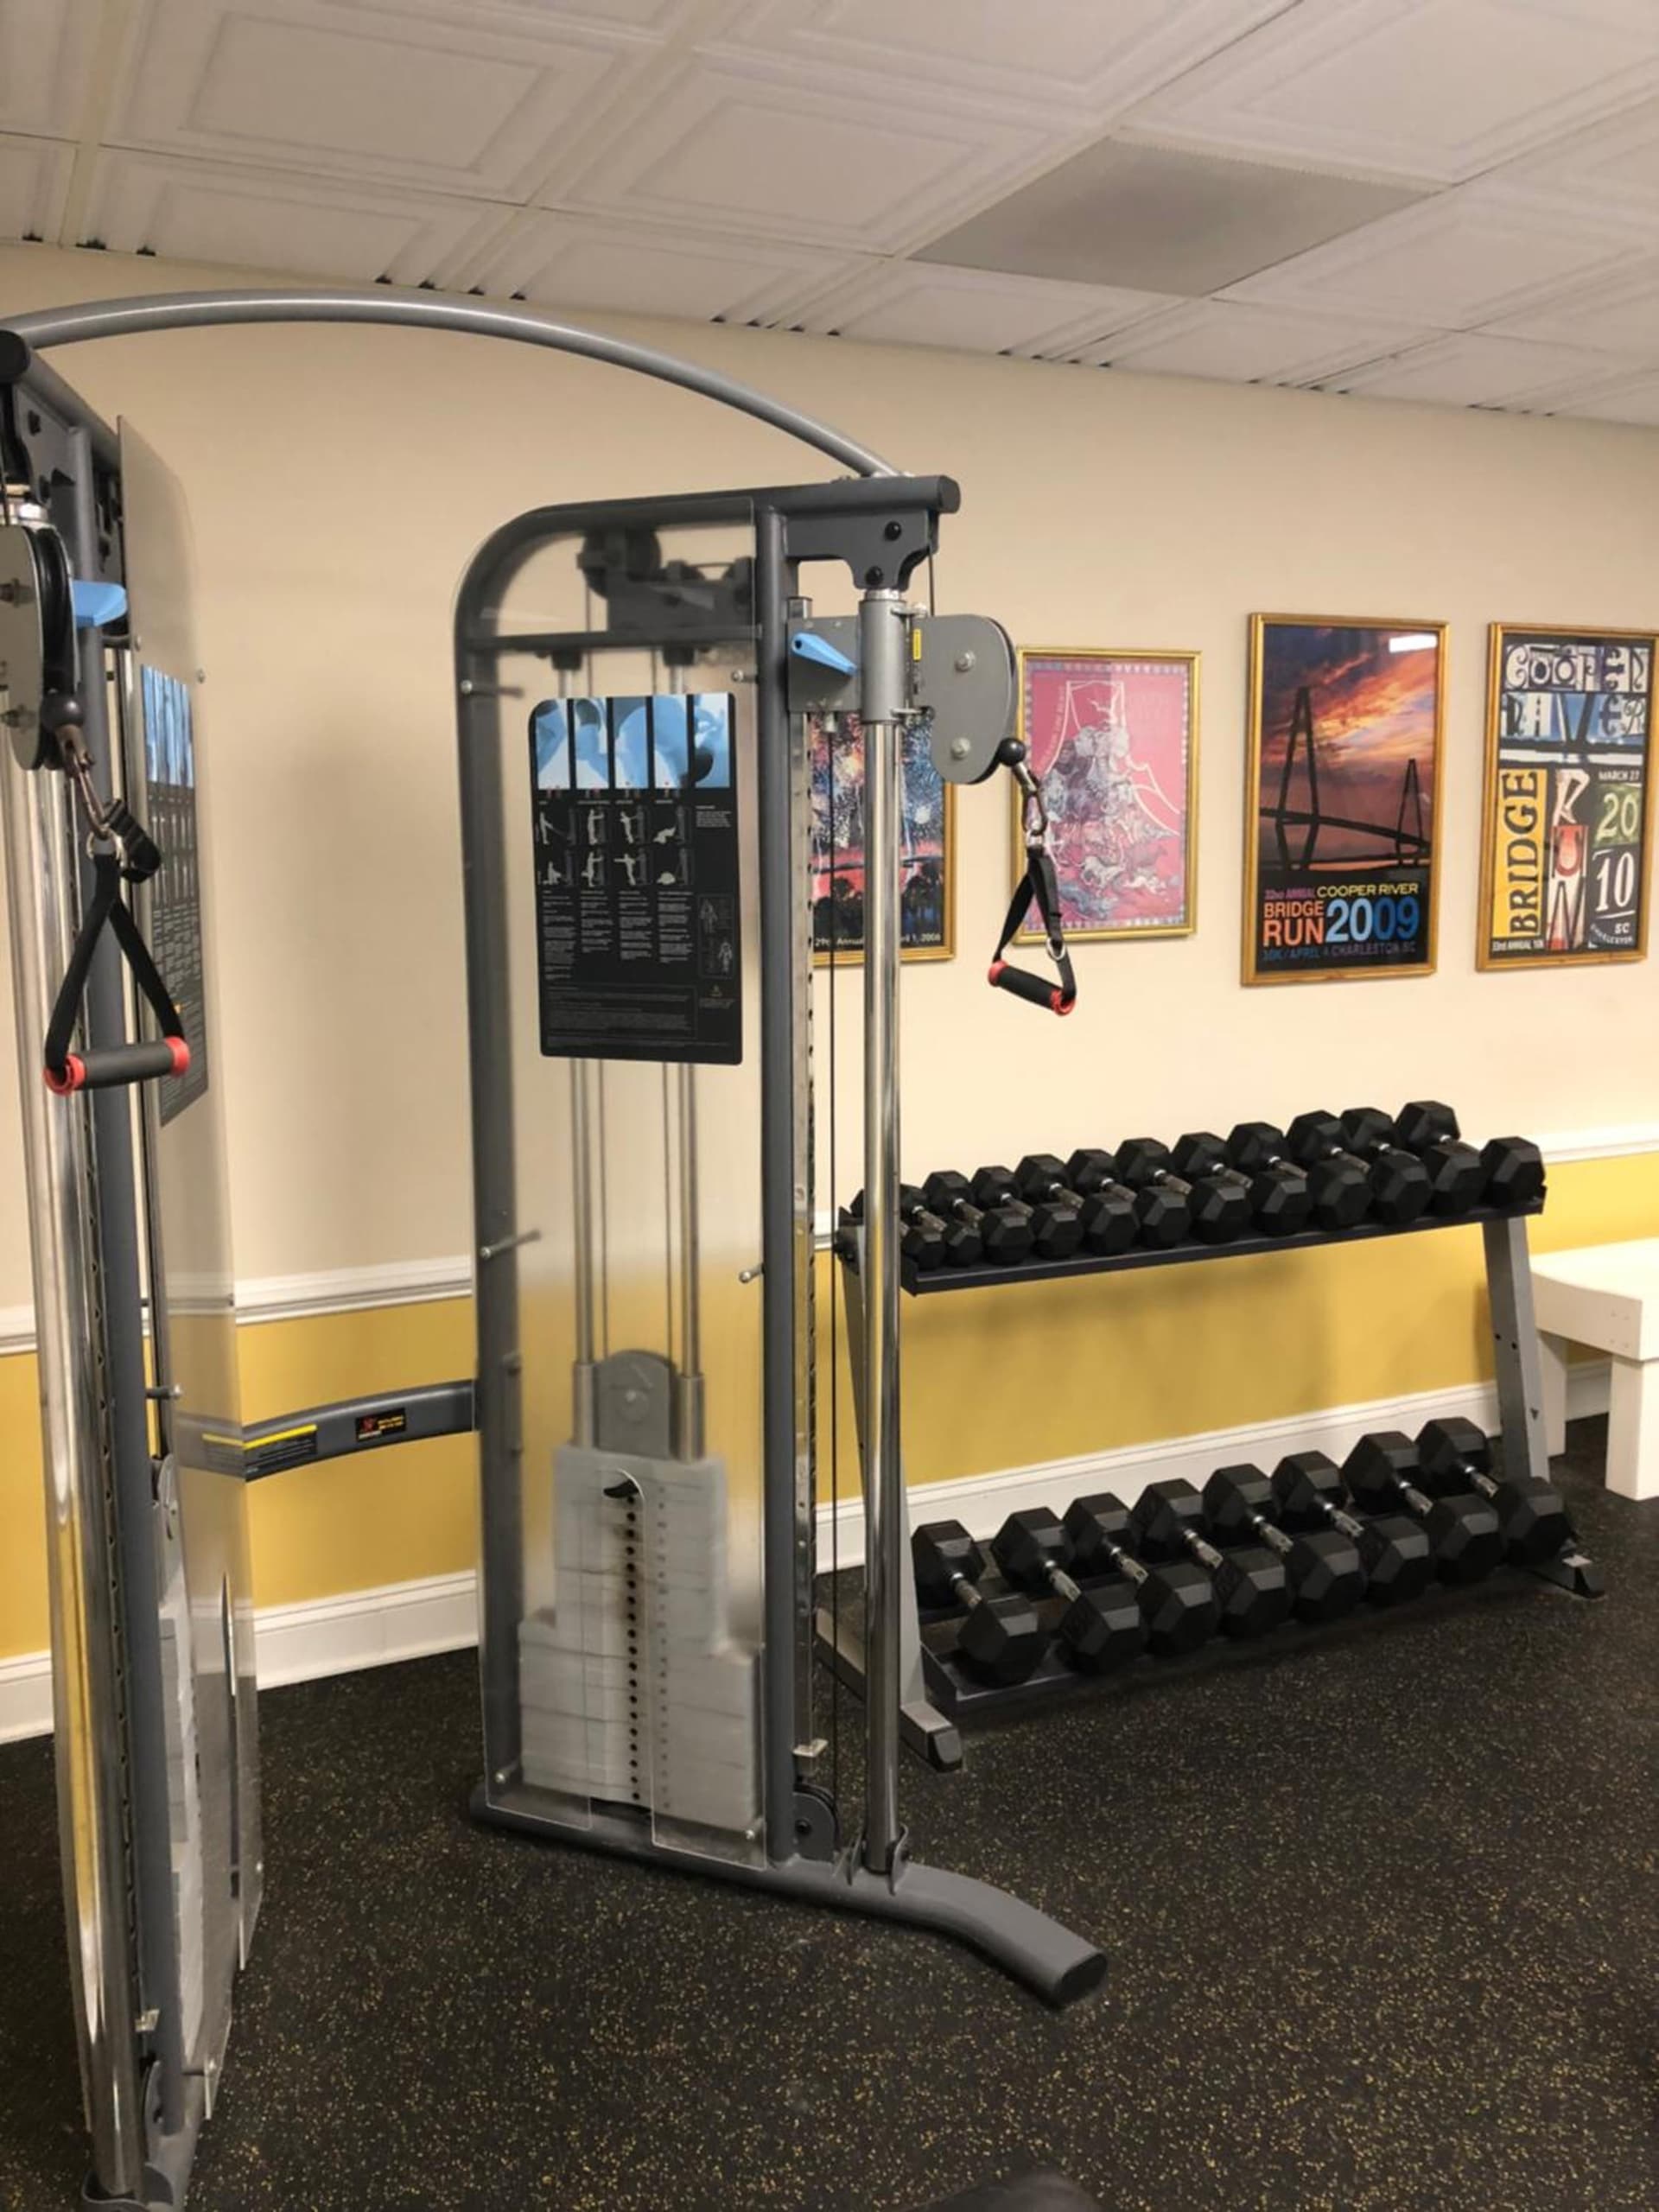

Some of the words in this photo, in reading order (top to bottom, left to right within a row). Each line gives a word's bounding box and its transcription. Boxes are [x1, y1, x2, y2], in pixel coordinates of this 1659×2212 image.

[1505, 693, 1646, 743] RIVER
[1599, 771, 1627, 781] MARCH
[1596, 792, 1638, 840] 20
[1501, 771, 1538, 935] BRIDGE
[1547, 768, 1590, 949] RUN
[1317, 883, 1376, 899] COOPER
[1378, 882, 1419, 895] RIVER
[1595, 851, 1636, 912] 10
[1262, 918, 1324, 947] RUN
[1263, 900, 1325, 918] BRIDGE
[1325, 896, 1420, 943] 2009
[1614, 922, 1630, 935] SC
